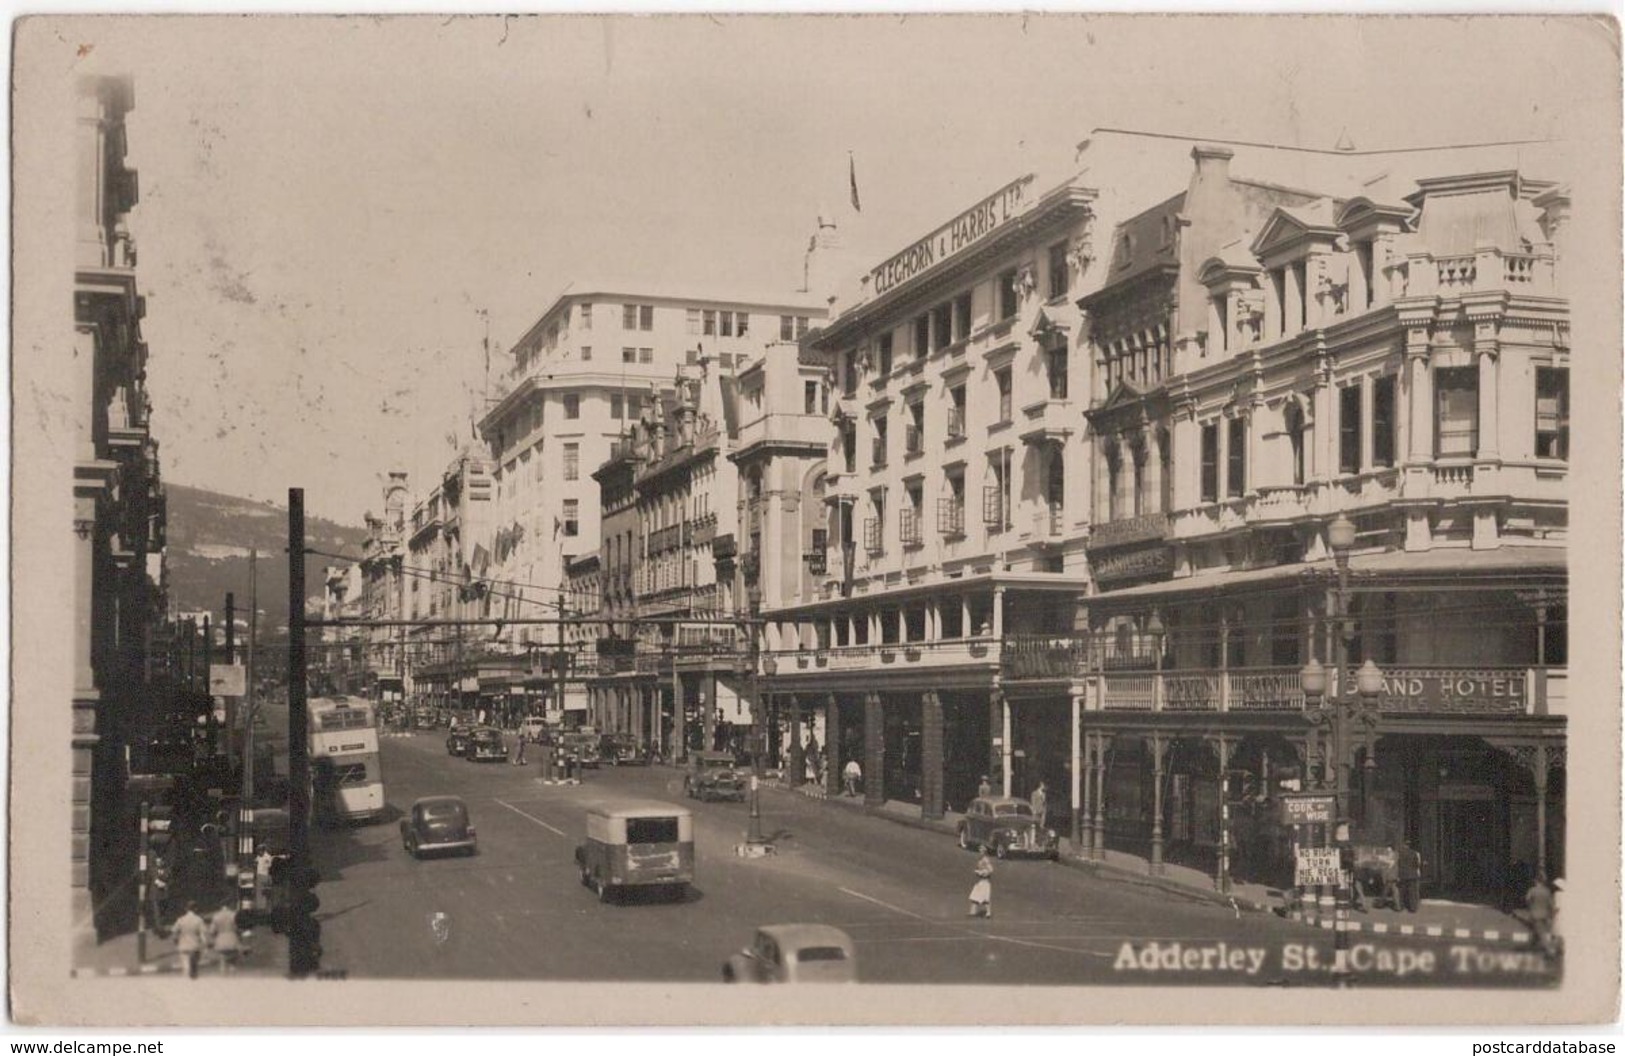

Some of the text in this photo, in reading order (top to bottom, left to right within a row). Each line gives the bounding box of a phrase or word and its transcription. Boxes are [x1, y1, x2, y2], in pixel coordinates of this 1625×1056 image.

[875, 238, 934, 294] CLEGHORN
[940, 237, 946, 257] &
[951, 200, 996, 251] HARRIS
[1345, 678, 1521, 695] GAND HOTEL
[1307, 858, 1331, 867] TURN
